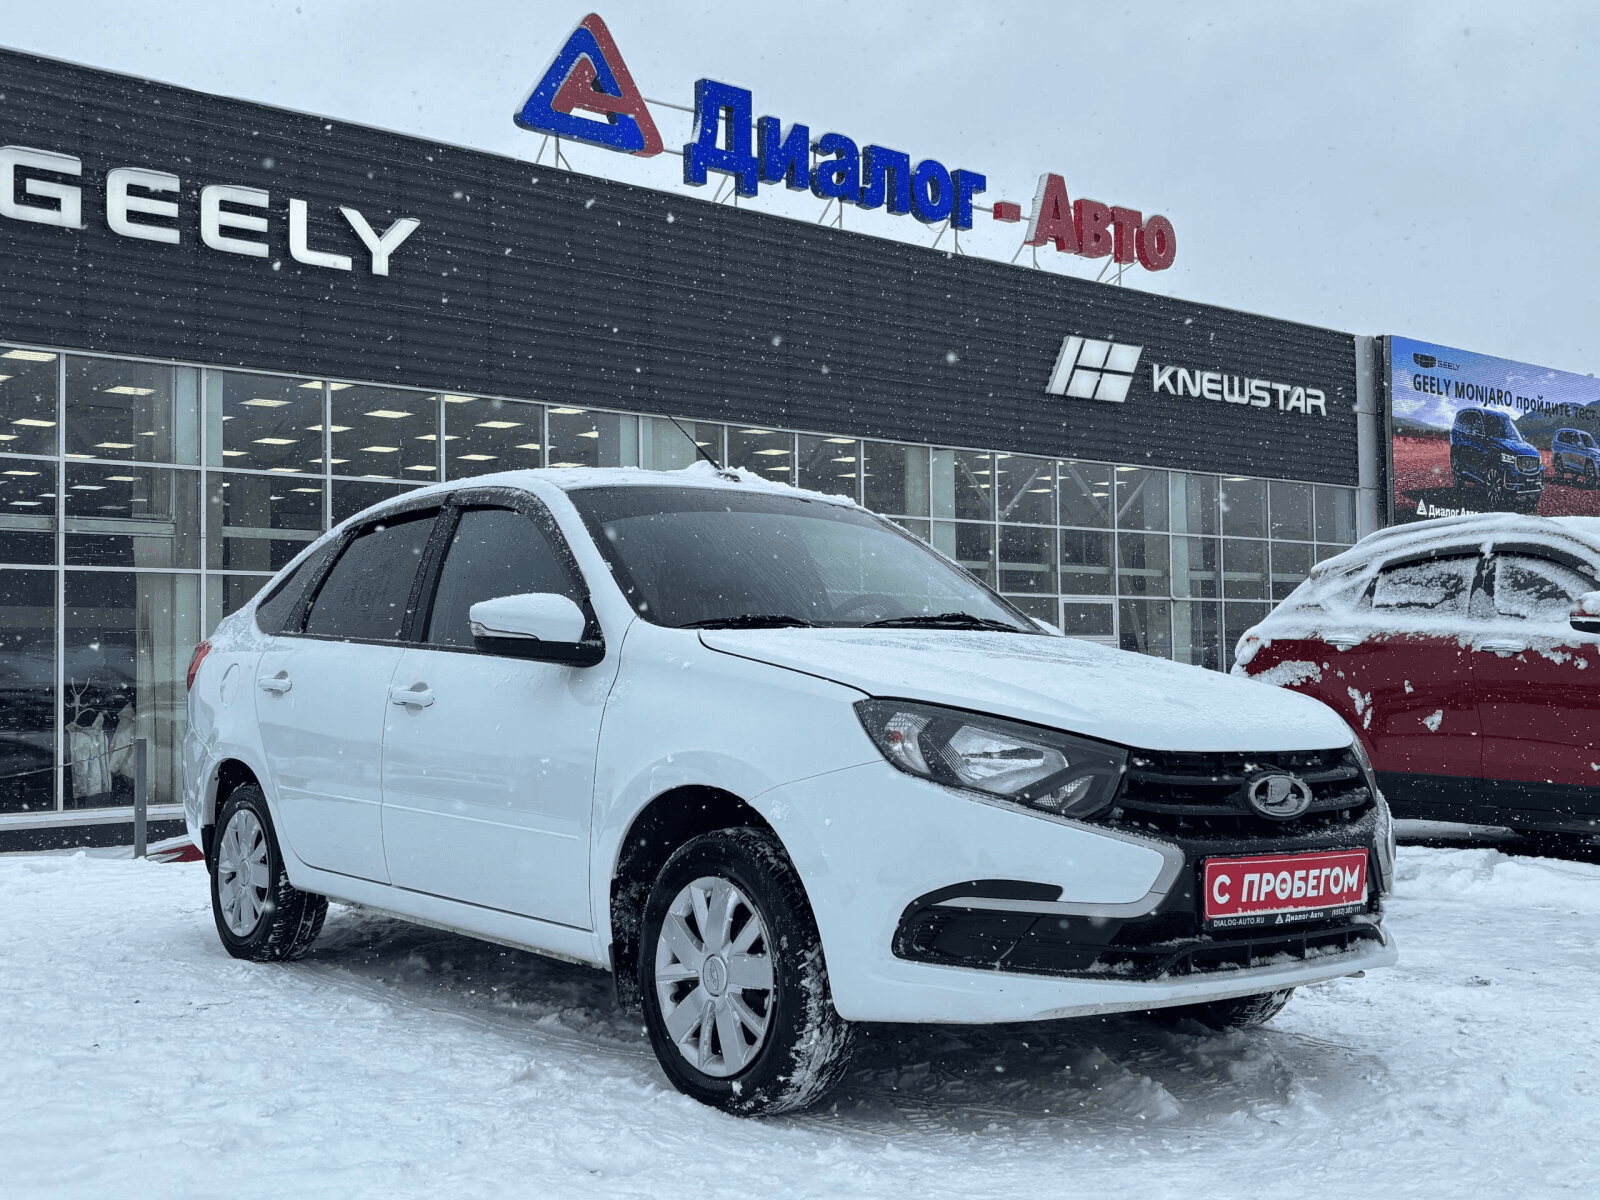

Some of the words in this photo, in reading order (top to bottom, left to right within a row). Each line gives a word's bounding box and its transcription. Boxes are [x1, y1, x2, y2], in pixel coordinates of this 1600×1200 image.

[0, 145, 421, 277] GEELY
[1437, 360, 1461, 371] GEELY
[1152, 363, 1327, 417] KNEWSTAR
[1413, 373, 1452, 397] GEELY
[1454, 380, 1513, 408] MONJARO
[1516, 395, 1571, 418] пройдите
[1429, 504, 1459, 518] Диалог
[1213, 874, 1231, 904] С
[1241, 864, 1360, 903] ПРОБЕГОМ
[1213, 917, 1265, 928] DIALOG-AUTO.RU
[1285, 911, 1324, 923] Диалог-Авто
